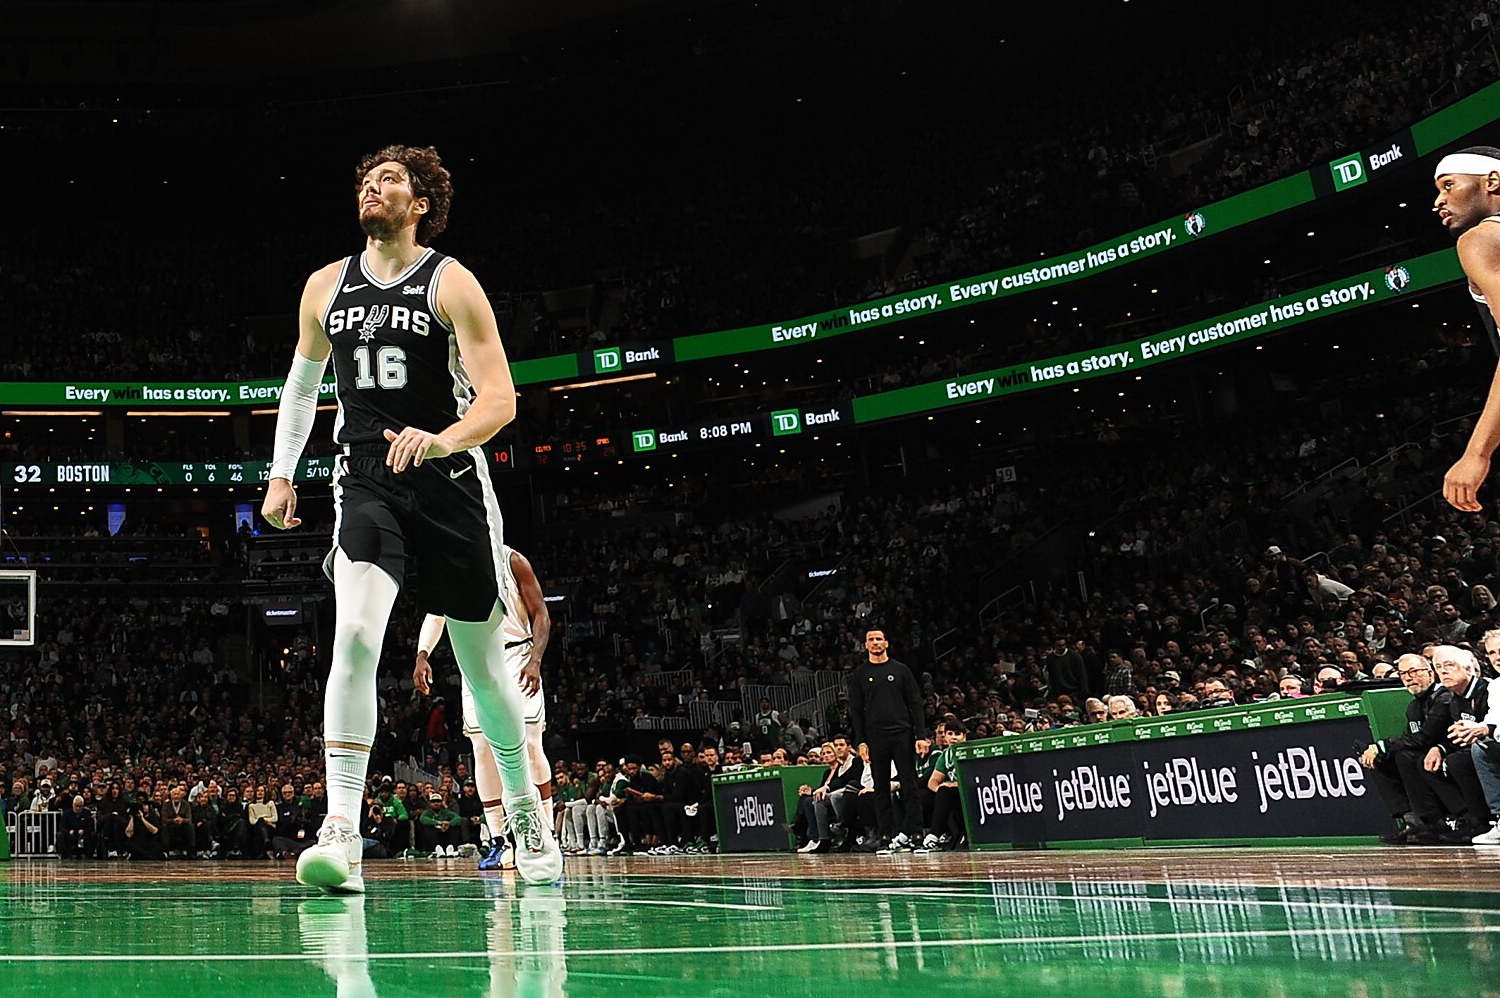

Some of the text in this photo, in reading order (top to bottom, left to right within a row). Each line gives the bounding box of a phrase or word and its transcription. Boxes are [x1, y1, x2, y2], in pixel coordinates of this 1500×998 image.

[1334, 144, 1404, 185] TD Bank
[772, 226, 1177, 343] Every win has a story. Every customer has a story.
[596, 347, 660, 369] TD Bank
[946, 281, 1376, 399] Every win has a story. Every customer has a story.
[354, 345, 407, 389] 16
[66, 384, 282, 403] Every win has a story. Every
[635, 428, 689, 448] TD Bank
[700, 421, 753, 440] 8:08 PM
[774, 409, 840, 431] TD Bank
[13, 465, 42, 483] 32
[57, 465, 110, 482] BOSTON
[185, 467, 329, 482] 0 6 46 5/10
[494, 452, 508, 463] 10
[1053, 765, 1131, 821] jetBlue
[1143, 756, 1238, 818] jetBlue
[1252, 746, 1367, 813] jetBlue
[734, 796, 774, 834] jetBlue
[975, 773, 1043, 825] jetBlue
